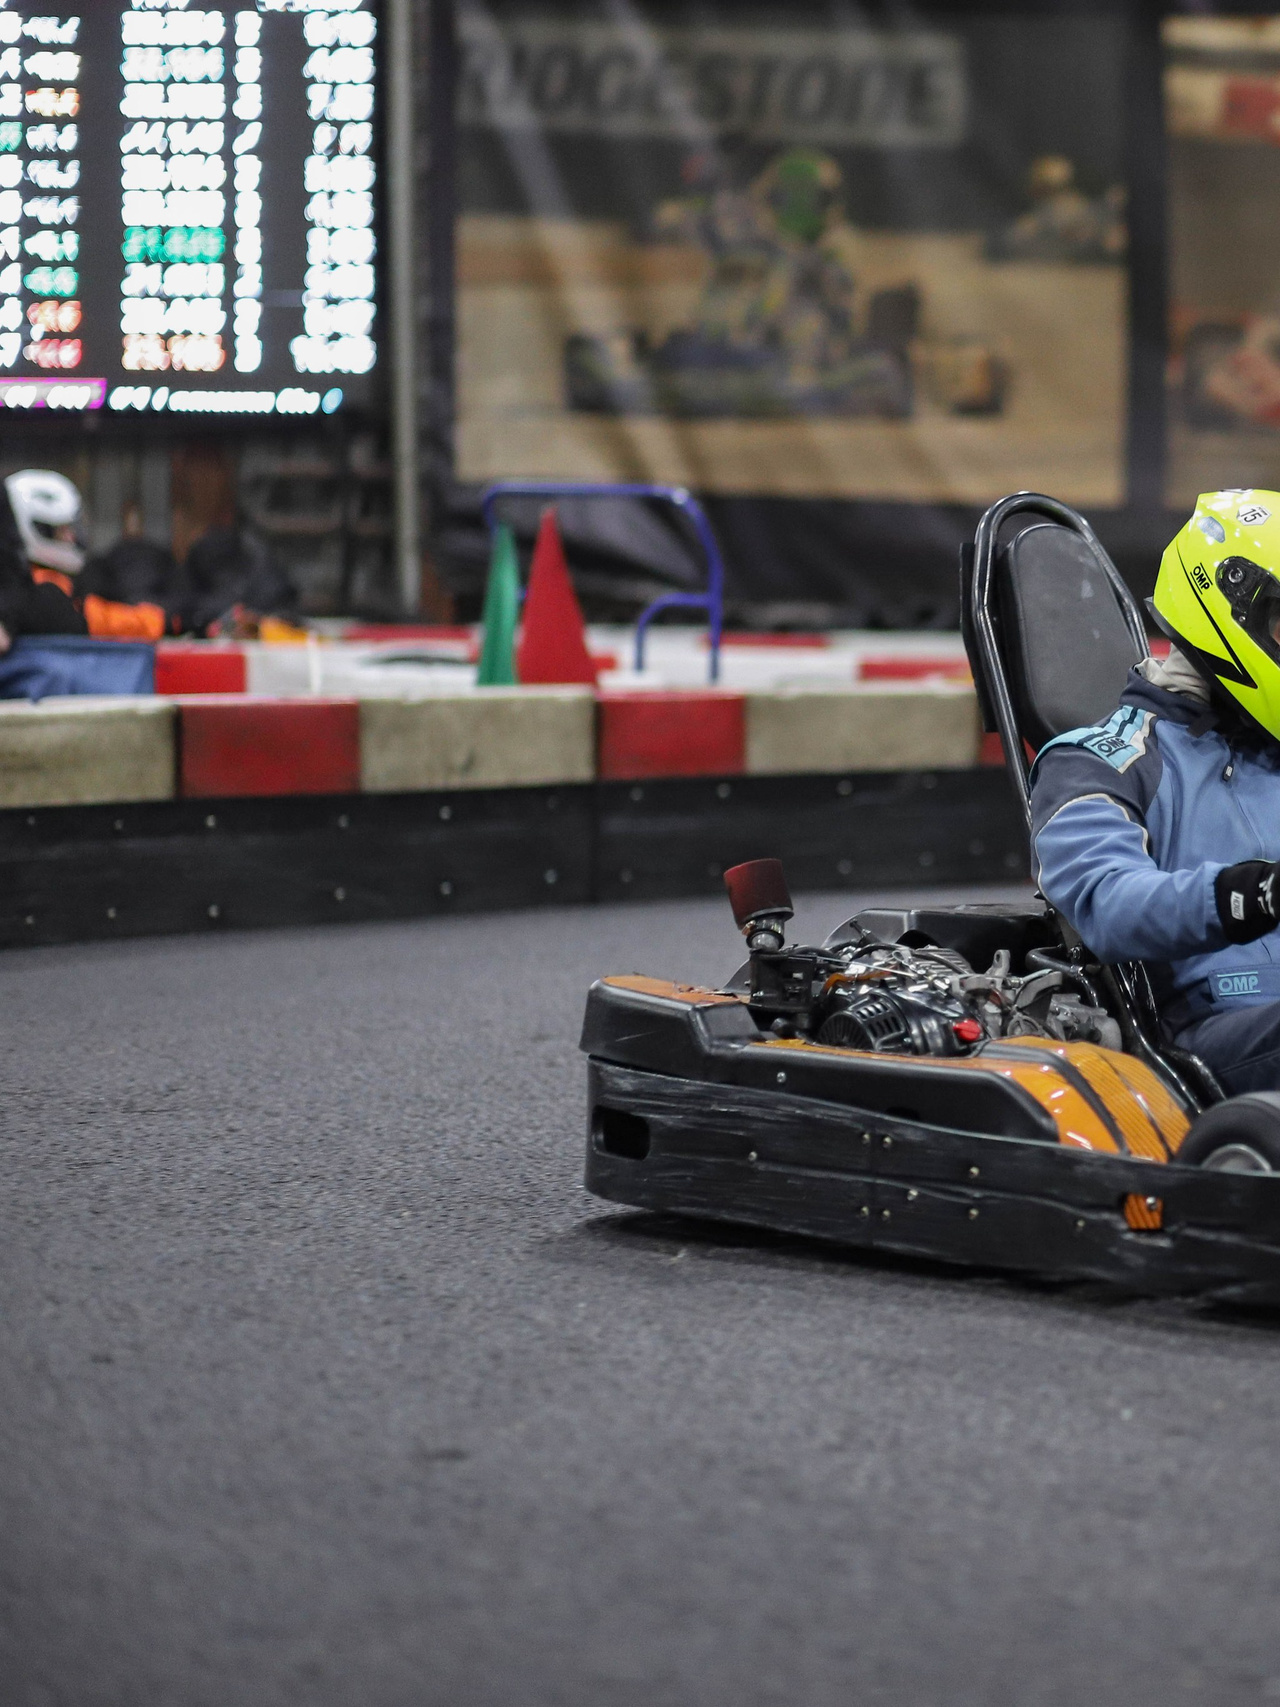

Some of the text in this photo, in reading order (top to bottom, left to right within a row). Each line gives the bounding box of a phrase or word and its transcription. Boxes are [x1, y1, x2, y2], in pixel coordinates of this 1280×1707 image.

[1240, 508, 1262, 523] 15
[1193, 565, 1210, 590] OMP
[1218, 975, 1258, 993] OMP
